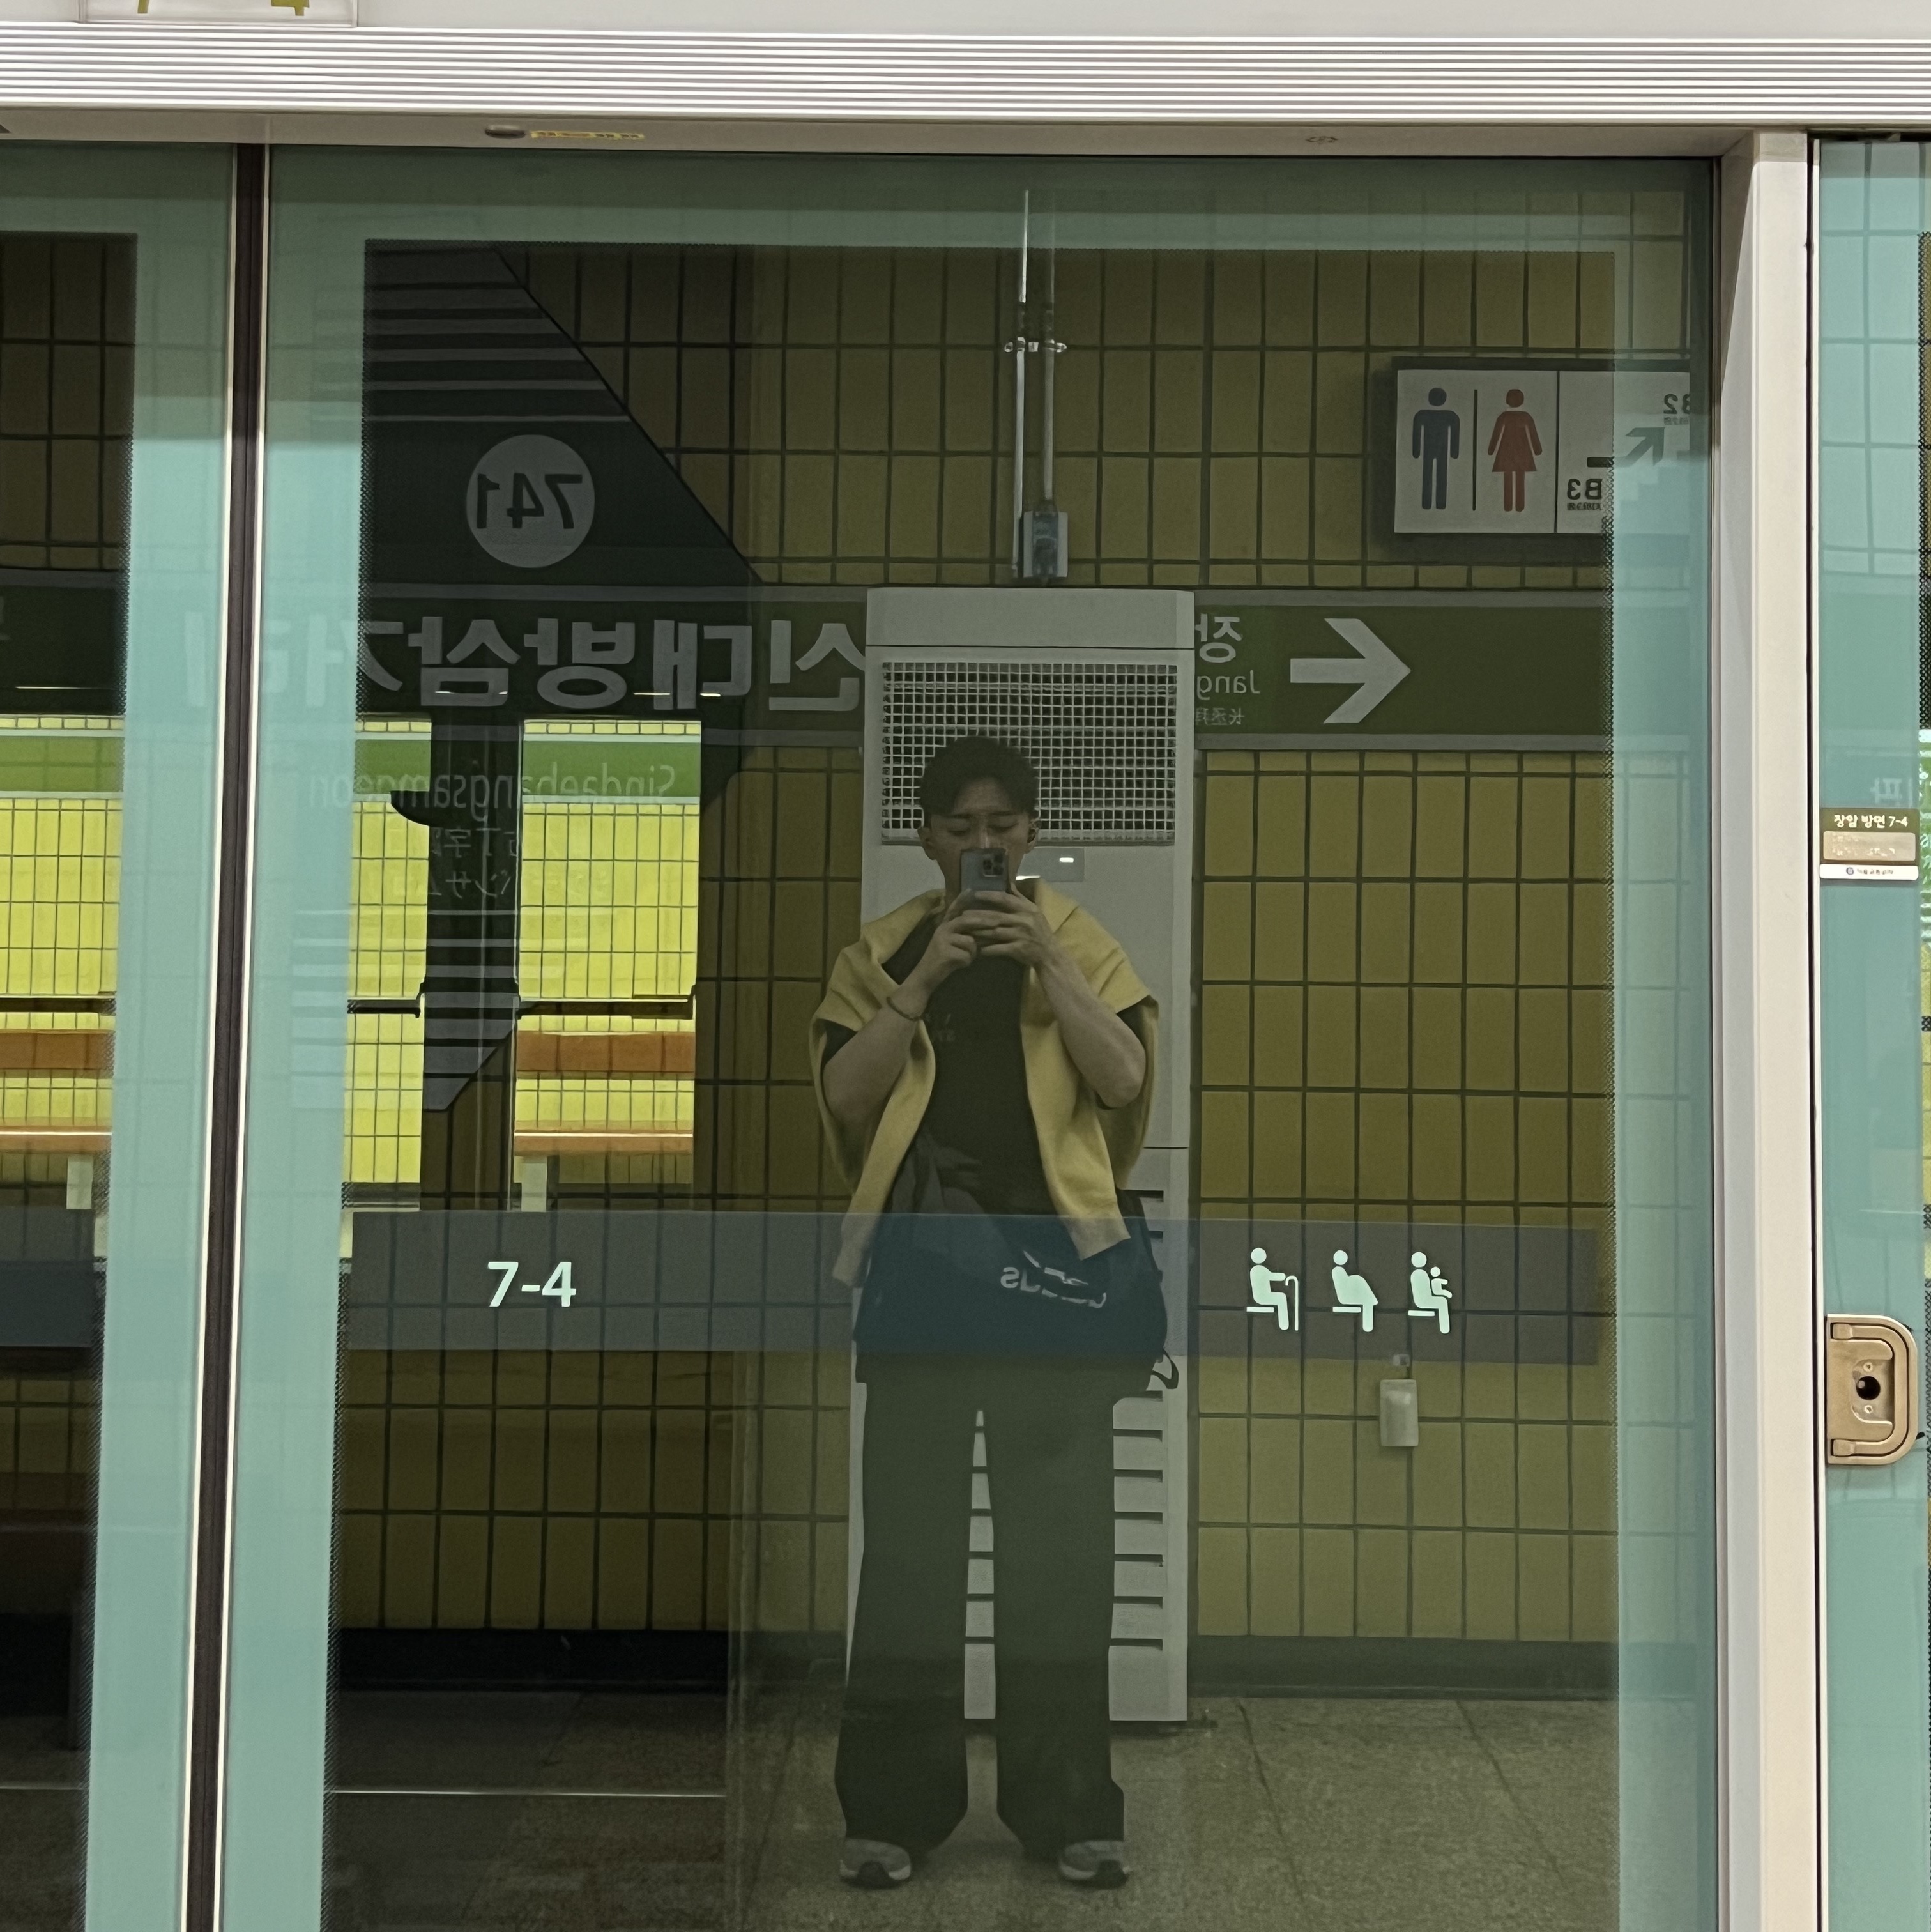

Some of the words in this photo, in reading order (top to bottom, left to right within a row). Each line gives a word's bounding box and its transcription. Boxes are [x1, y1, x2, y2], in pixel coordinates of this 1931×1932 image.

[1861, 815, 1885, 829] 방면
[1888, 816, 1908, 827] 7-4
[487, 1261, 577, 1307] 7-4
